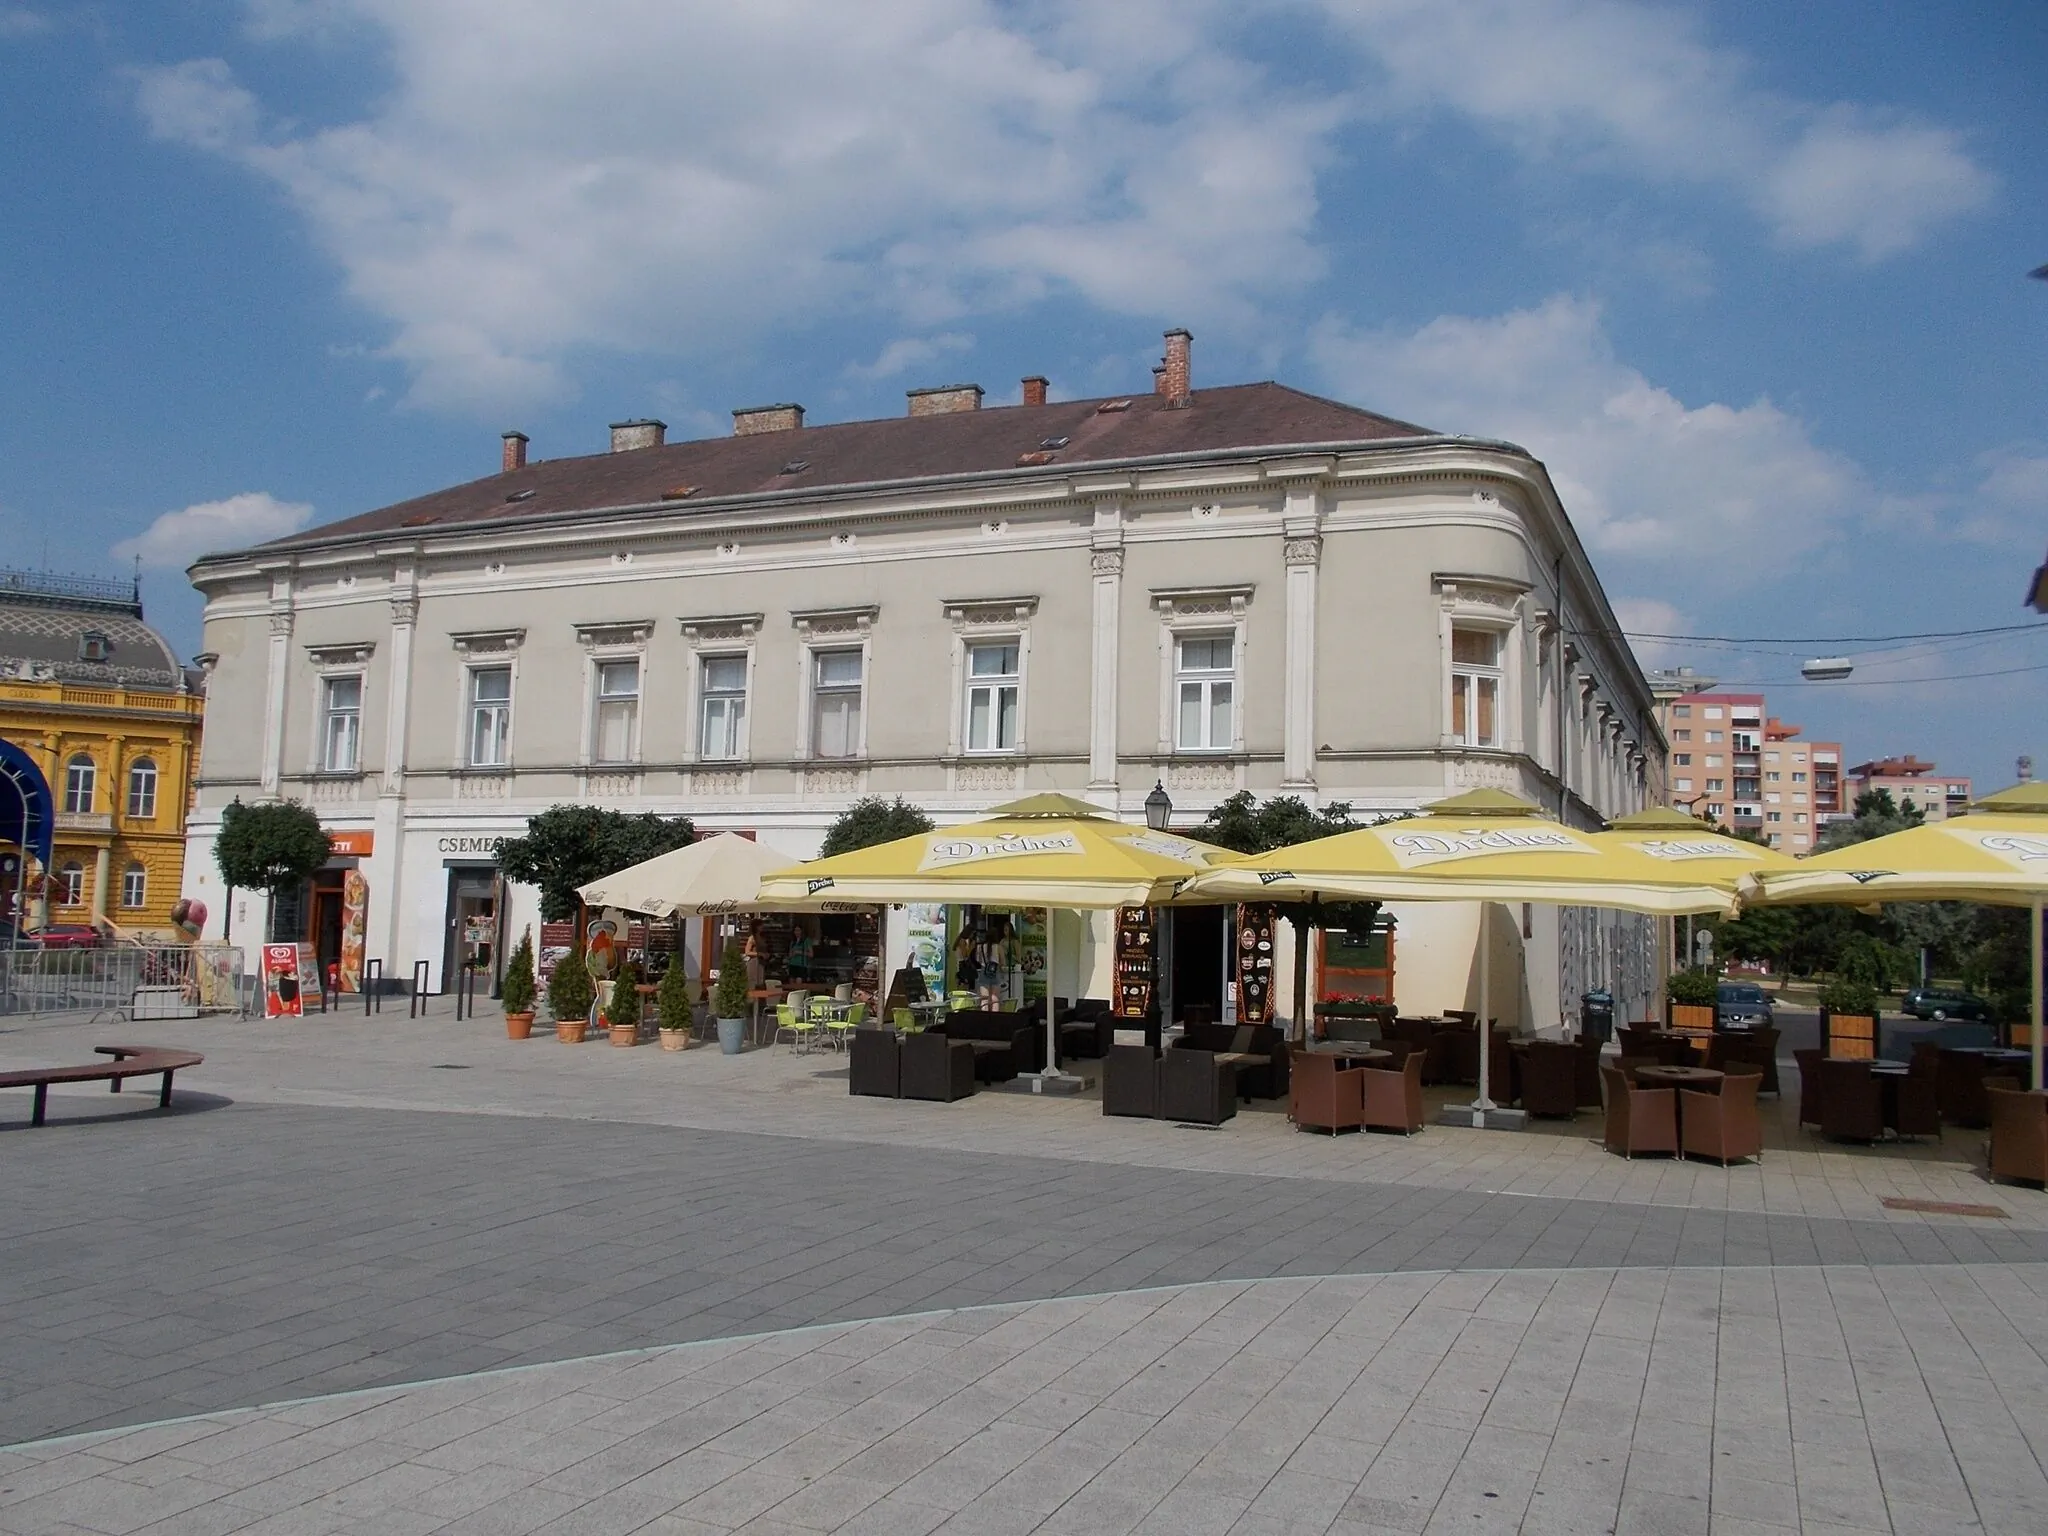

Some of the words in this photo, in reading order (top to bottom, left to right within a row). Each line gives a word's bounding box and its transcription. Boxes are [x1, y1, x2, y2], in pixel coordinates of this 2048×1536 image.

[438, 837, 514, 853] CSEMEG
[933, 838, 1073, 861] Dreher
[1393, 831, 1573, 856] Dreher
[1643, 842, 1740, 858] reher
